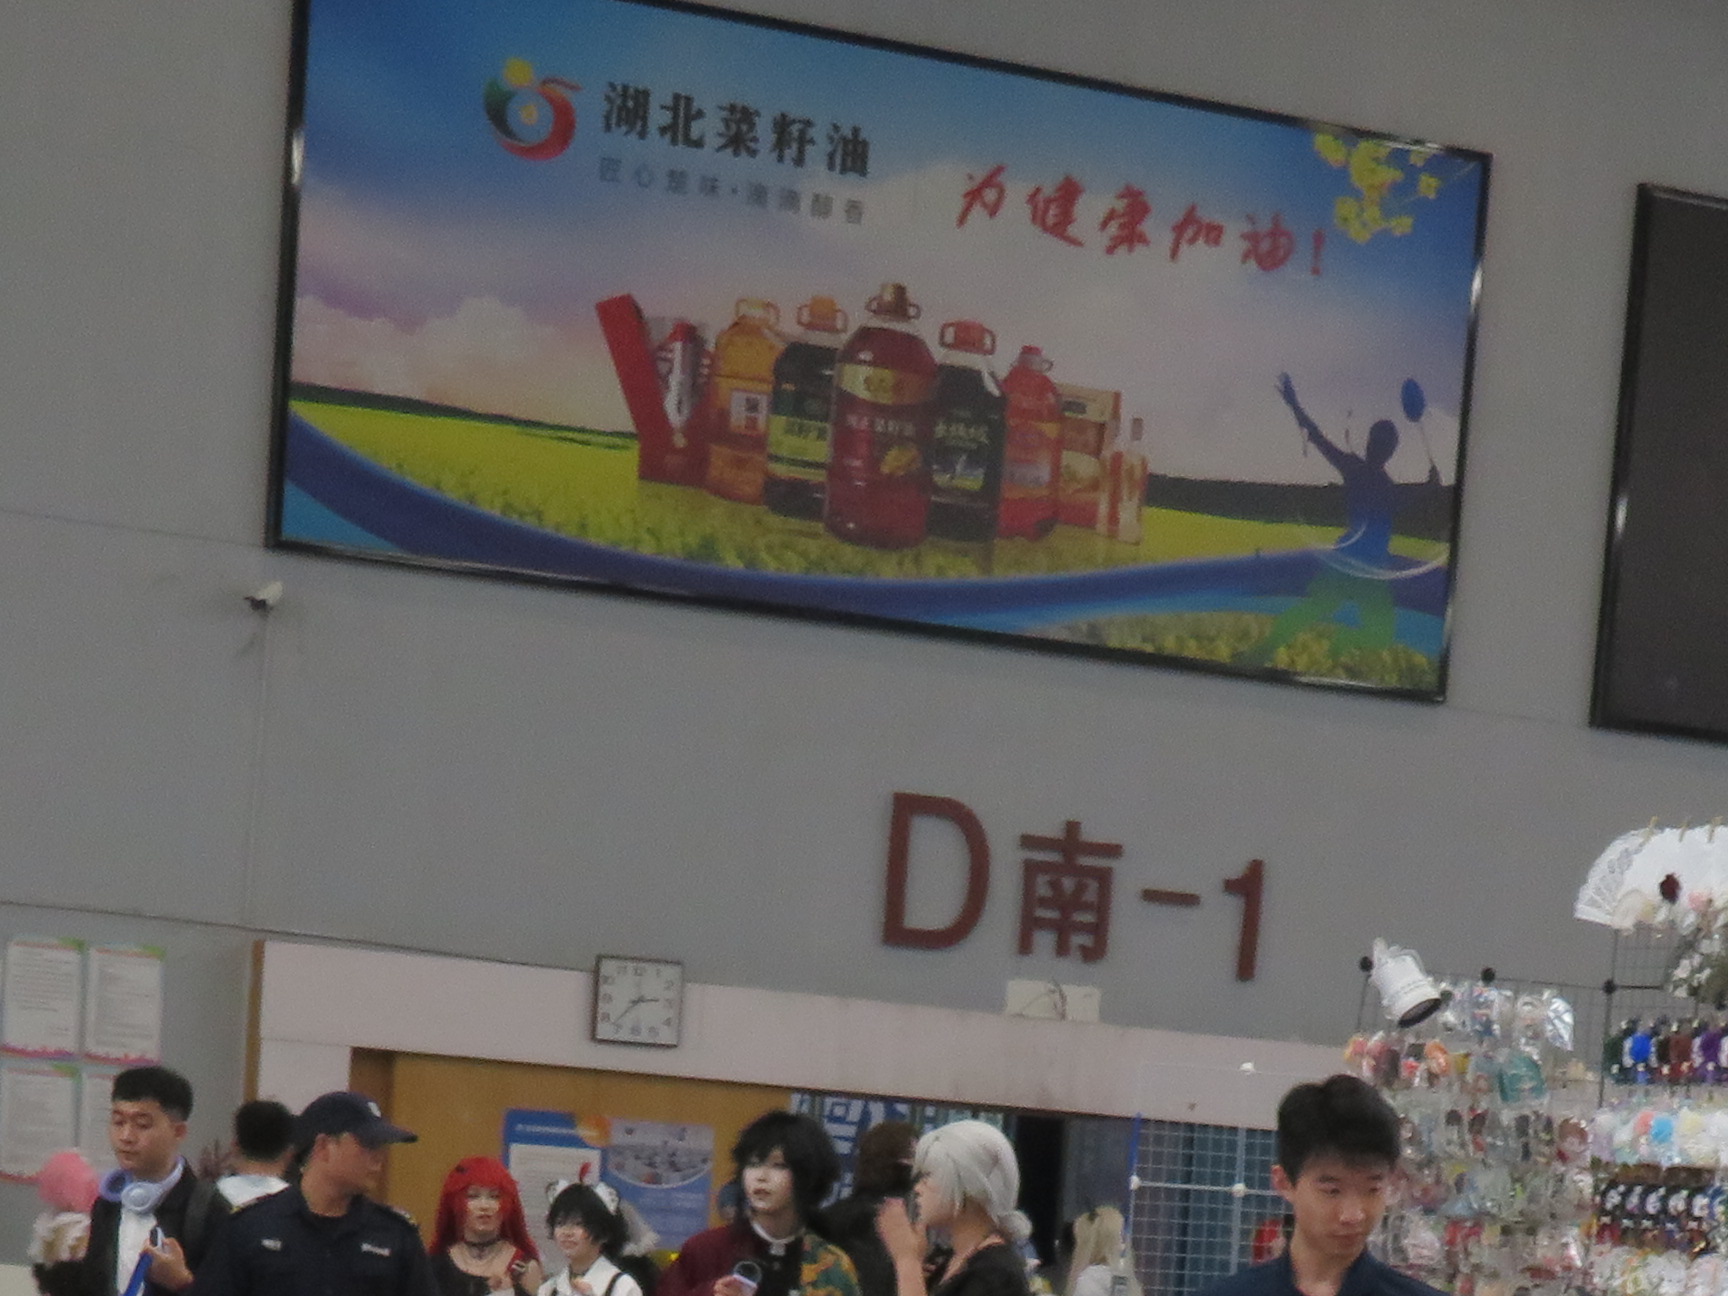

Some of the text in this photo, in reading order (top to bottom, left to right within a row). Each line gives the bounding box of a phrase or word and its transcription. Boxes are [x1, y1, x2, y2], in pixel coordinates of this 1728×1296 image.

[603, 82, 870, 178] 湖北菜籽油
[882, 791, 1265, 982] D南-1
